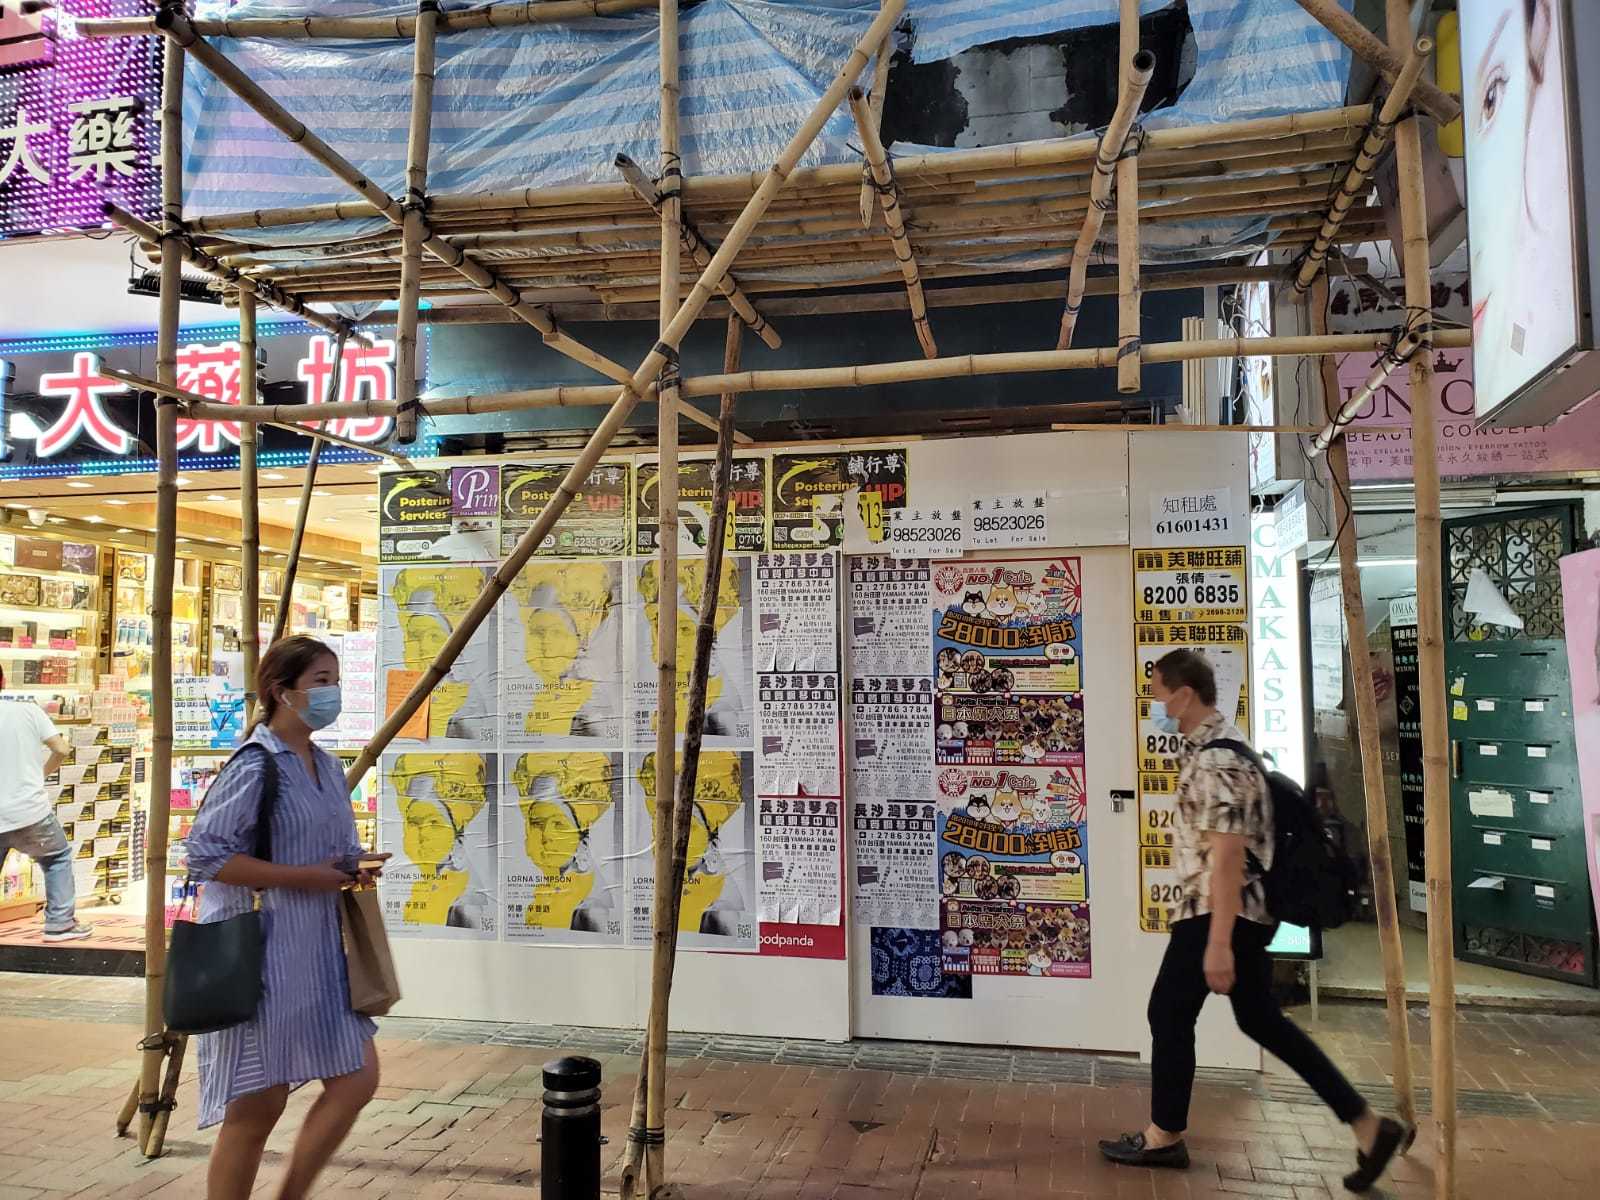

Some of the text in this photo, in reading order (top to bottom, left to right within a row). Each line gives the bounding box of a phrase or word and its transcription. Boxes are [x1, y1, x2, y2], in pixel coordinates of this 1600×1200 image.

[0, 96, 165, 184] 大藥
[37, 332, 398, 458] 大藥坊
[400, 496, 451, 507] Posterin
[973, 497, 1044, 511] 業主放盤
[1163, 494, 1217, 514] 知租處
[400, 510, 447, 521] Services
[894, 509, 962, 521] 業主放盤
[973, 514, 1045, 532] 98523026
[1156, 517, 1229, 535] 61601431
[893, 527, 961, 542] 98523026
[1143, 585, 1239, 605] 8200 6835
[507, 682, 572, 691] LORNA SIMPSON
[1146, 735, 1183, 754] 820
[412, 873, 448, 881] SIMPSON
[507, 875, 572, 883] LORNA SIMPSON
